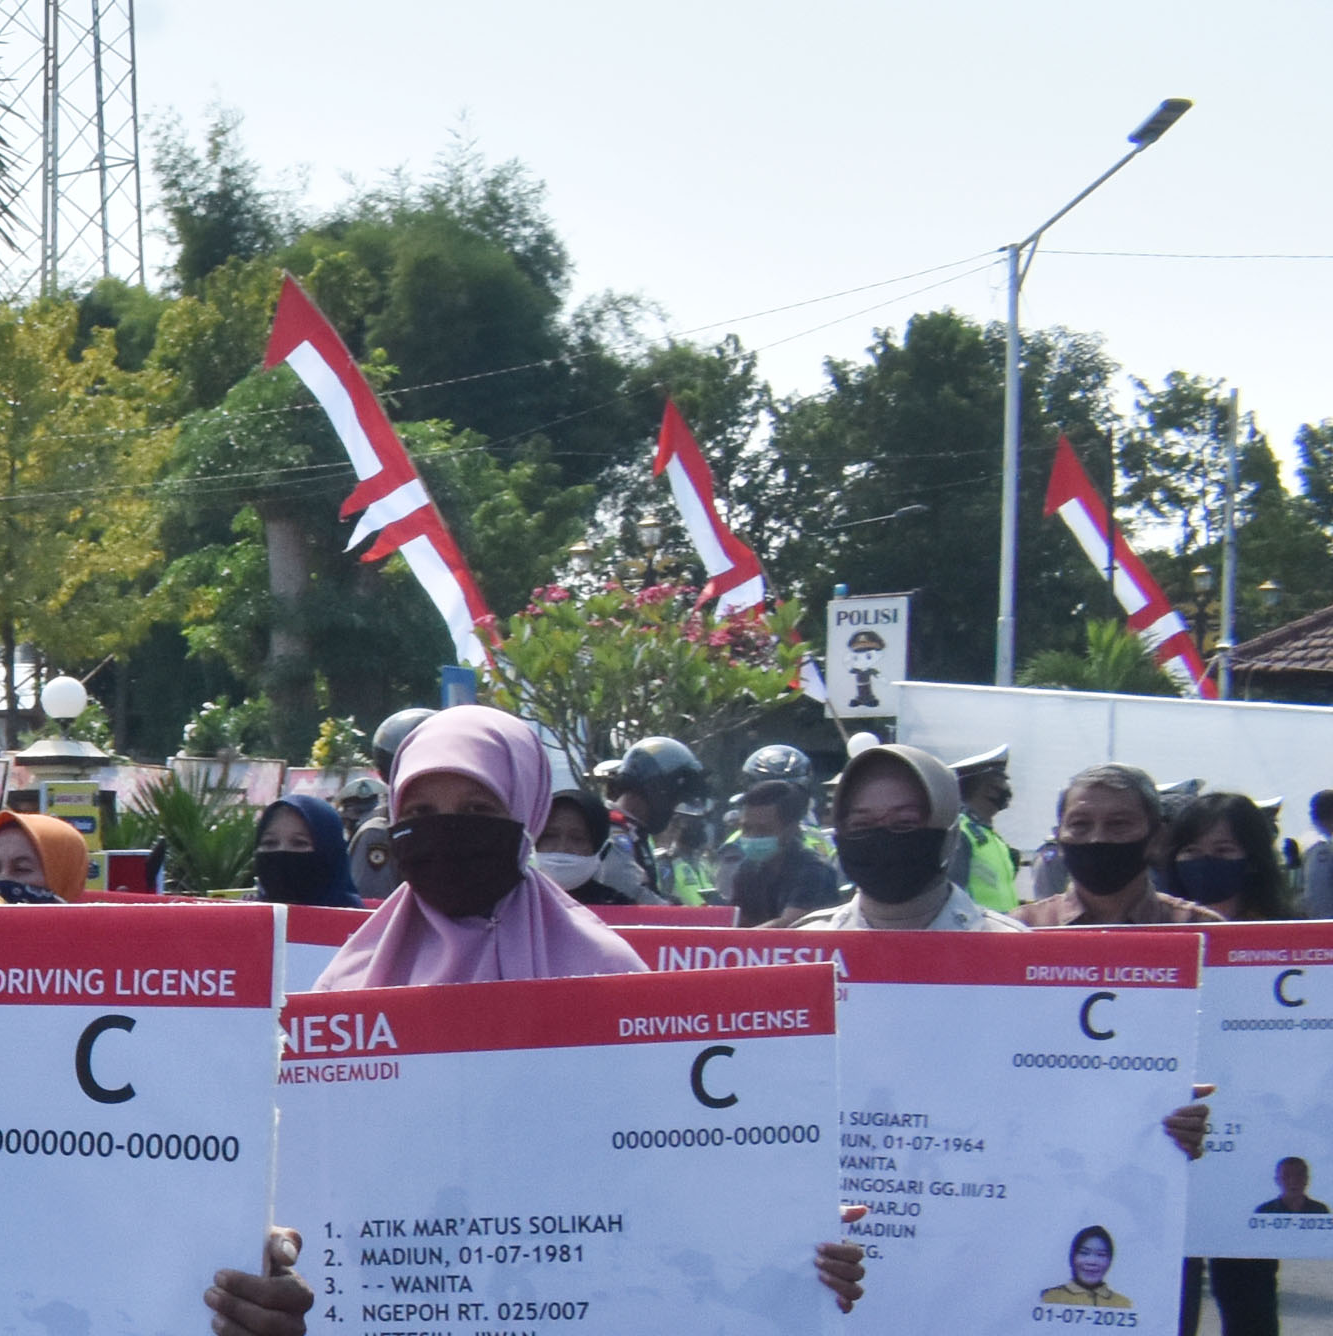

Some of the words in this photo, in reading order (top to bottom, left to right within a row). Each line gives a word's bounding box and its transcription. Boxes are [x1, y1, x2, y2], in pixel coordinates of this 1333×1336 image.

[837, 609, 898, 626] POLISI
[1228, 950, 1288, 962] DRIVING
[116, 969, 235, 997] LICENSE
[1026, 965, 1099, 983] DRIVING
[1105, 966, 1178, 984] LICENSE
[1274, 969, 1304, 1007] C
[619, 1014, 709, 1038] DRIVING
[717, 1010, 808, 1032] LICENSE
[1079, 991, 1116, 1040] C
[281, 1013, 397, 1053] NESIA
[75, 1014, 136, 1104] C
[1013, 1053, 1177, 1073] 00000000-000000
[278, 1062, 399, 1084] MENGEMUDI
[690, 1045, 738, 1109] C
[851, 1112, 928, 1128] SUGIARTI
[612, 1125, 820, 1150] 00000000-000000
[884, 1136, 985, 1152] 01-07-1964
[841, 1178, 923, 1194] INGOSARI
[360, 1217, 407, 1238] ATIK
[413, 1216, 521, 1237] MAR'ATUS
[530, 1215, 622, 1235] SOLIKAH
[848, 1223, 916, 1238] MADIUN
[361, 1246, 451, 1271] MADIUN,
[459, 1245, 584, 1265] 01-07-1981
[391, 1275, 473, 1294] WANITA
[362, 1303, 449, 1323] NGEPOH
[458, 1304, 489, 1322] RT.
[497, 1302, 589, 1322] 025/007
[1032, 1306, 1138, 1328] 01-07-2025
